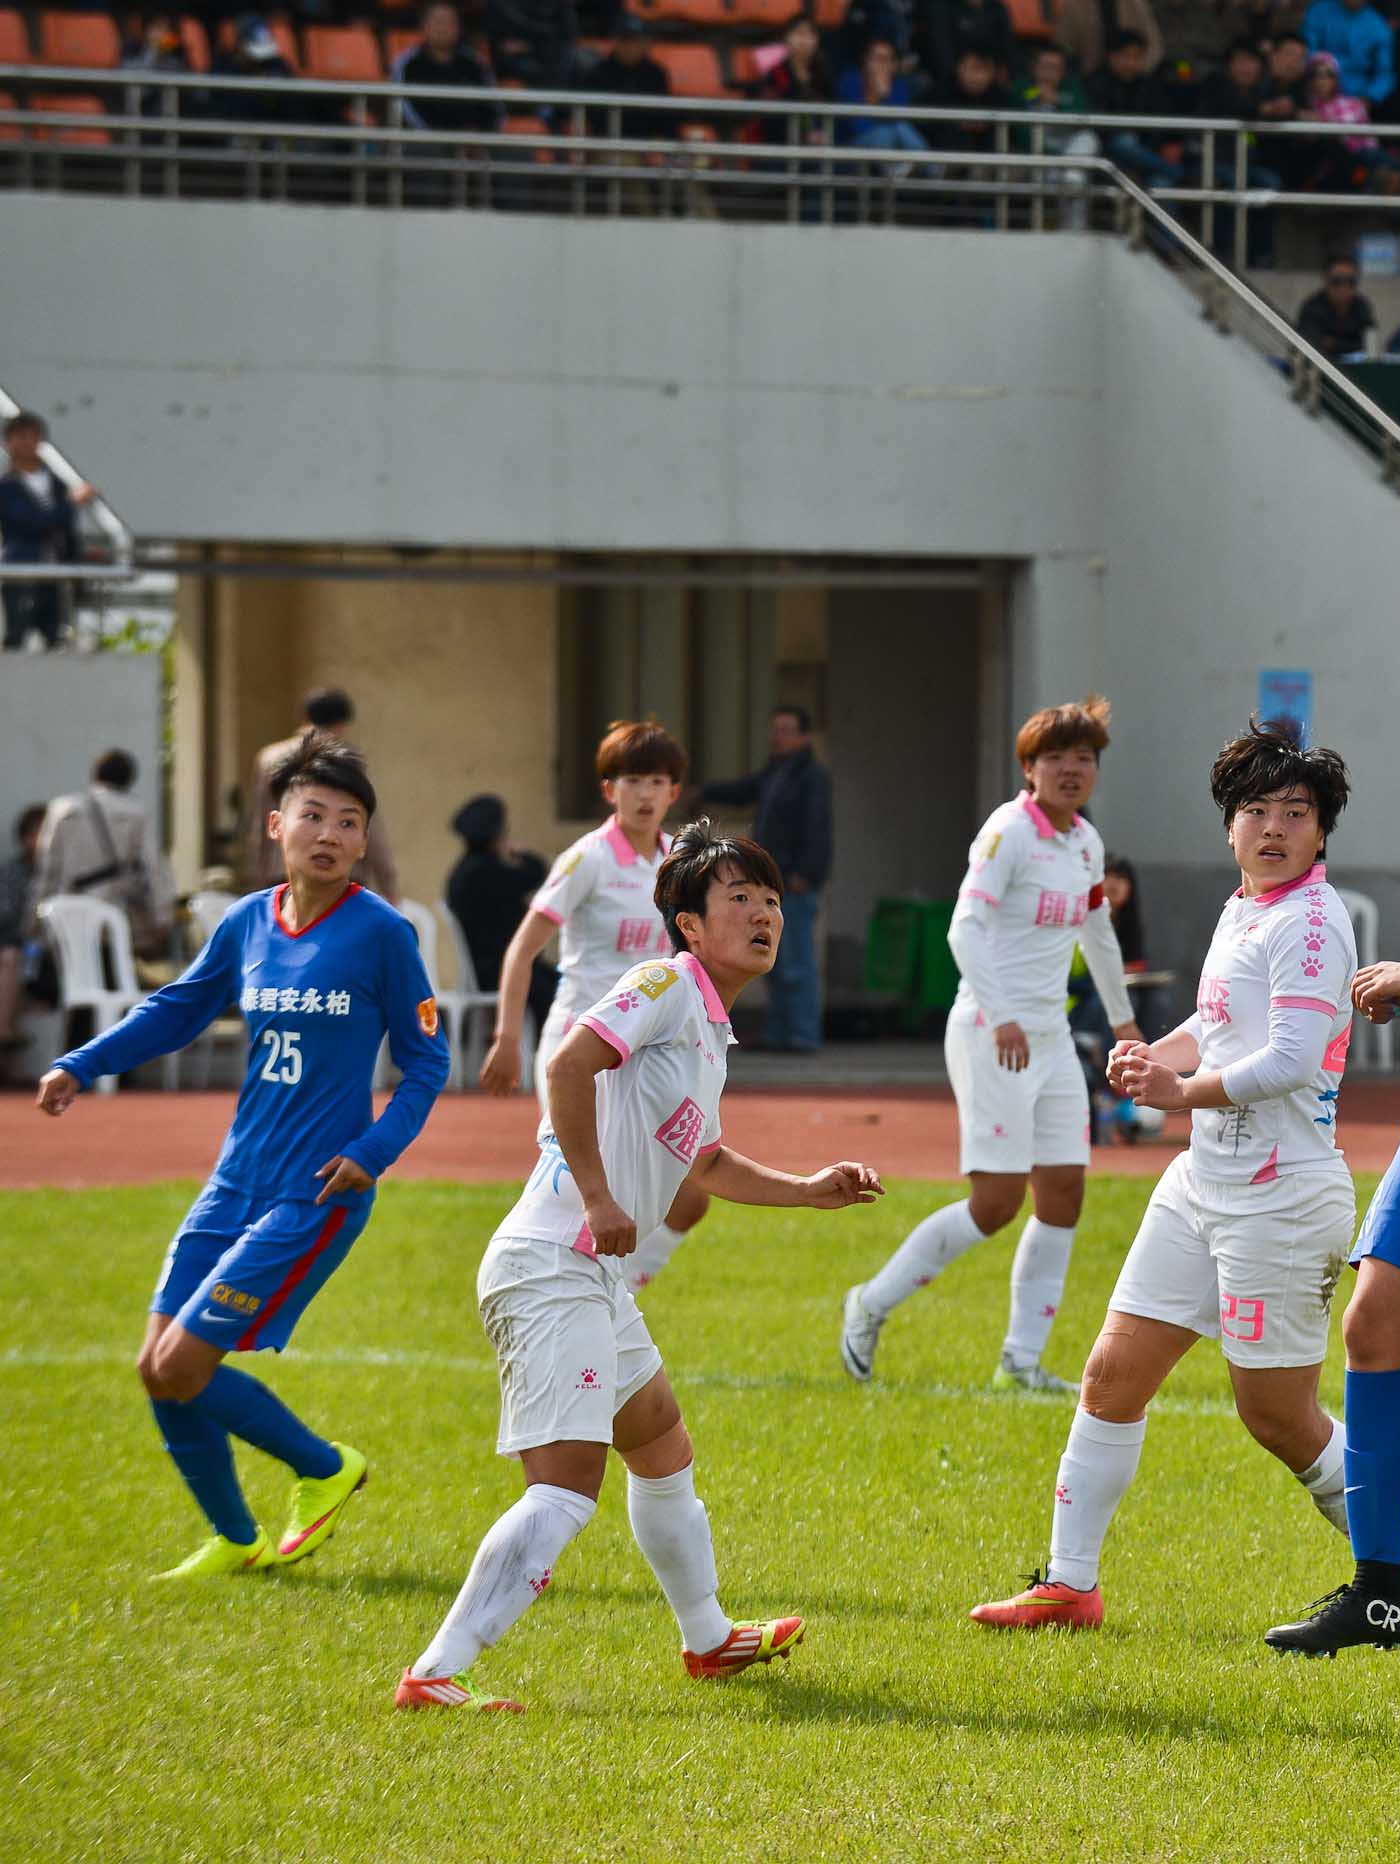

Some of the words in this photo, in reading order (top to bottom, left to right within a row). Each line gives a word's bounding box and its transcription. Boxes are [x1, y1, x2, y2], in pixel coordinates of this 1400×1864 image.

[260, 1028, 303, 1085] 25
[1217, 1105, 1256, 1157] 津
[1221, 1293, 1264, 1341] 23
